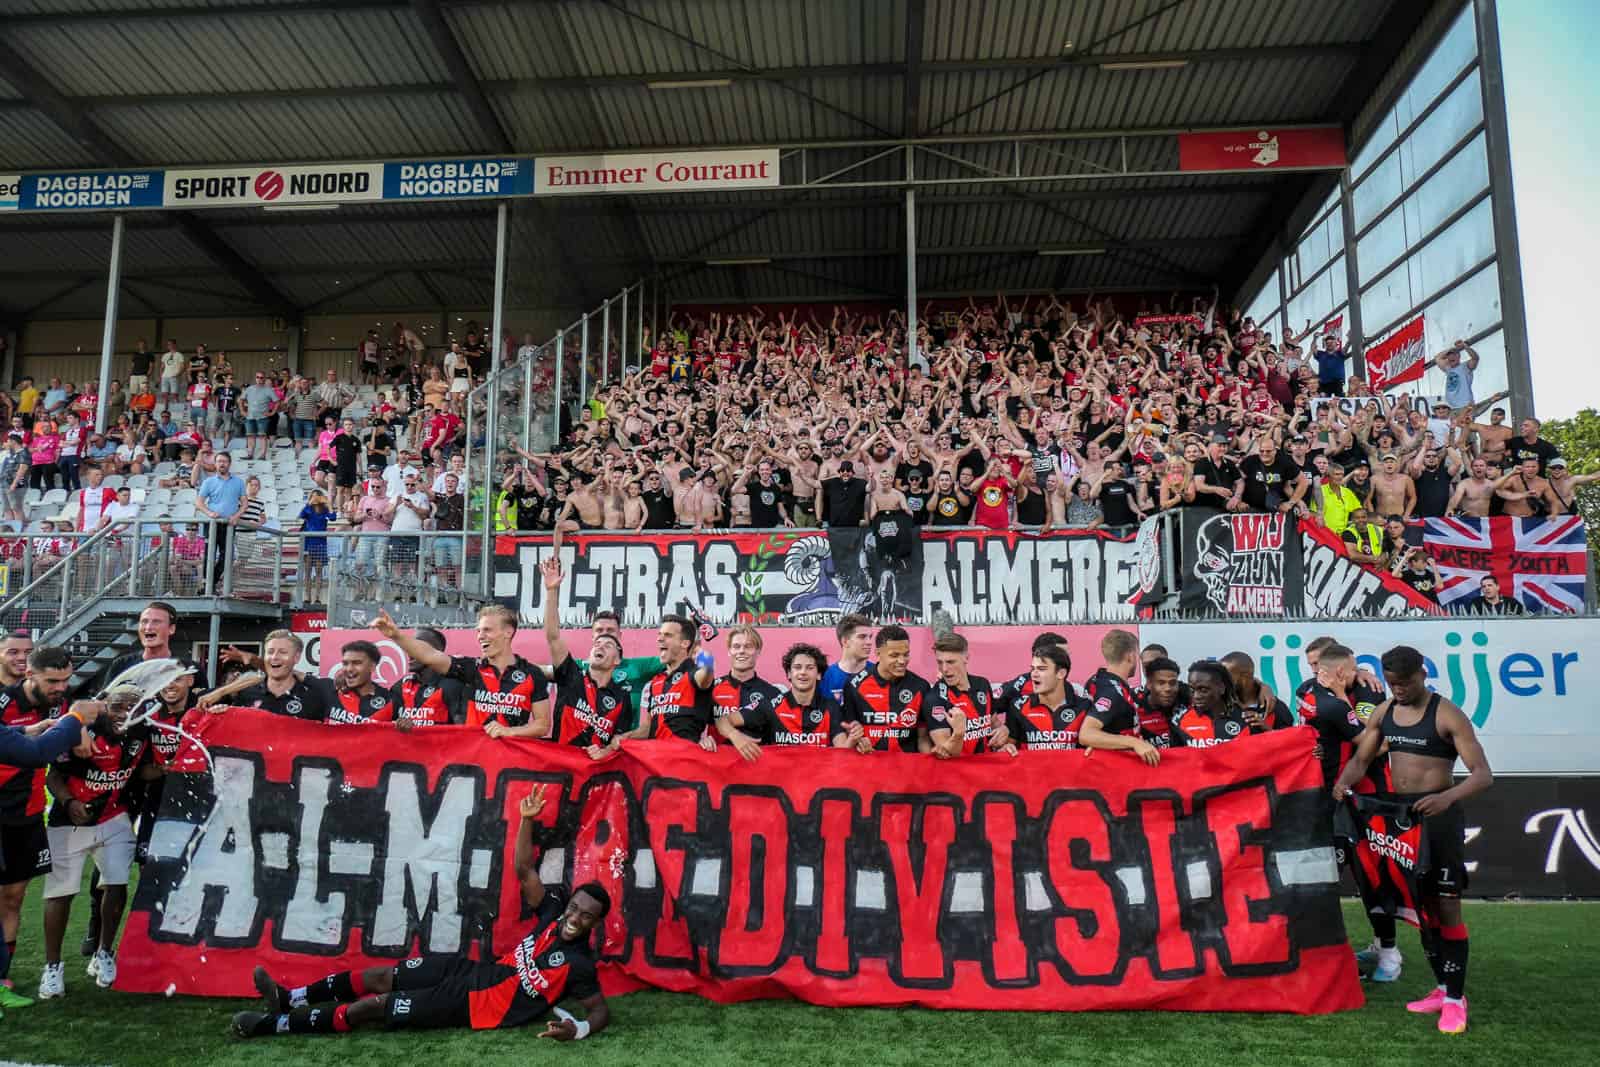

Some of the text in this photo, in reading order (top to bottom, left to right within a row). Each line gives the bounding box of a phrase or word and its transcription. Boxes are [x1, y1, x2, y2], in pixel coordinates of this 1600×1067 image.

[400, 162, 500, 180] DAGBLAD
[547, 160, 769, 188] Emmer Courant
[37, 175, 132, 191] DAGBLAD
[174, 171, 370, 200] SPORT NOORD
[400, 178, 500, 196] NOORDEN
[36, 190, 131, 207] NOORDEN
[1230, 512, 1285, 552] WIJ
[1228, 551, 1285, 588] ZIJN
[519, 543, 738, 625] ULTRAS
[922, 539, 1137, 625] ALMERE
[1227, 586, 1284, 614] ALMERE
[475, 689, 521, 706] MASCOT
[475, 703, 522, 717] WORKWEAR
[863, 711, 898, 724] TSR
[775, 731, 821, 744] MASCOT
[1026, 731, 1073, 743] MASCOT
[86, 766, 134, 782] MASCO
[84, 779, 126, 792] WORKW
[1440, 867, 1449, 881] 7
